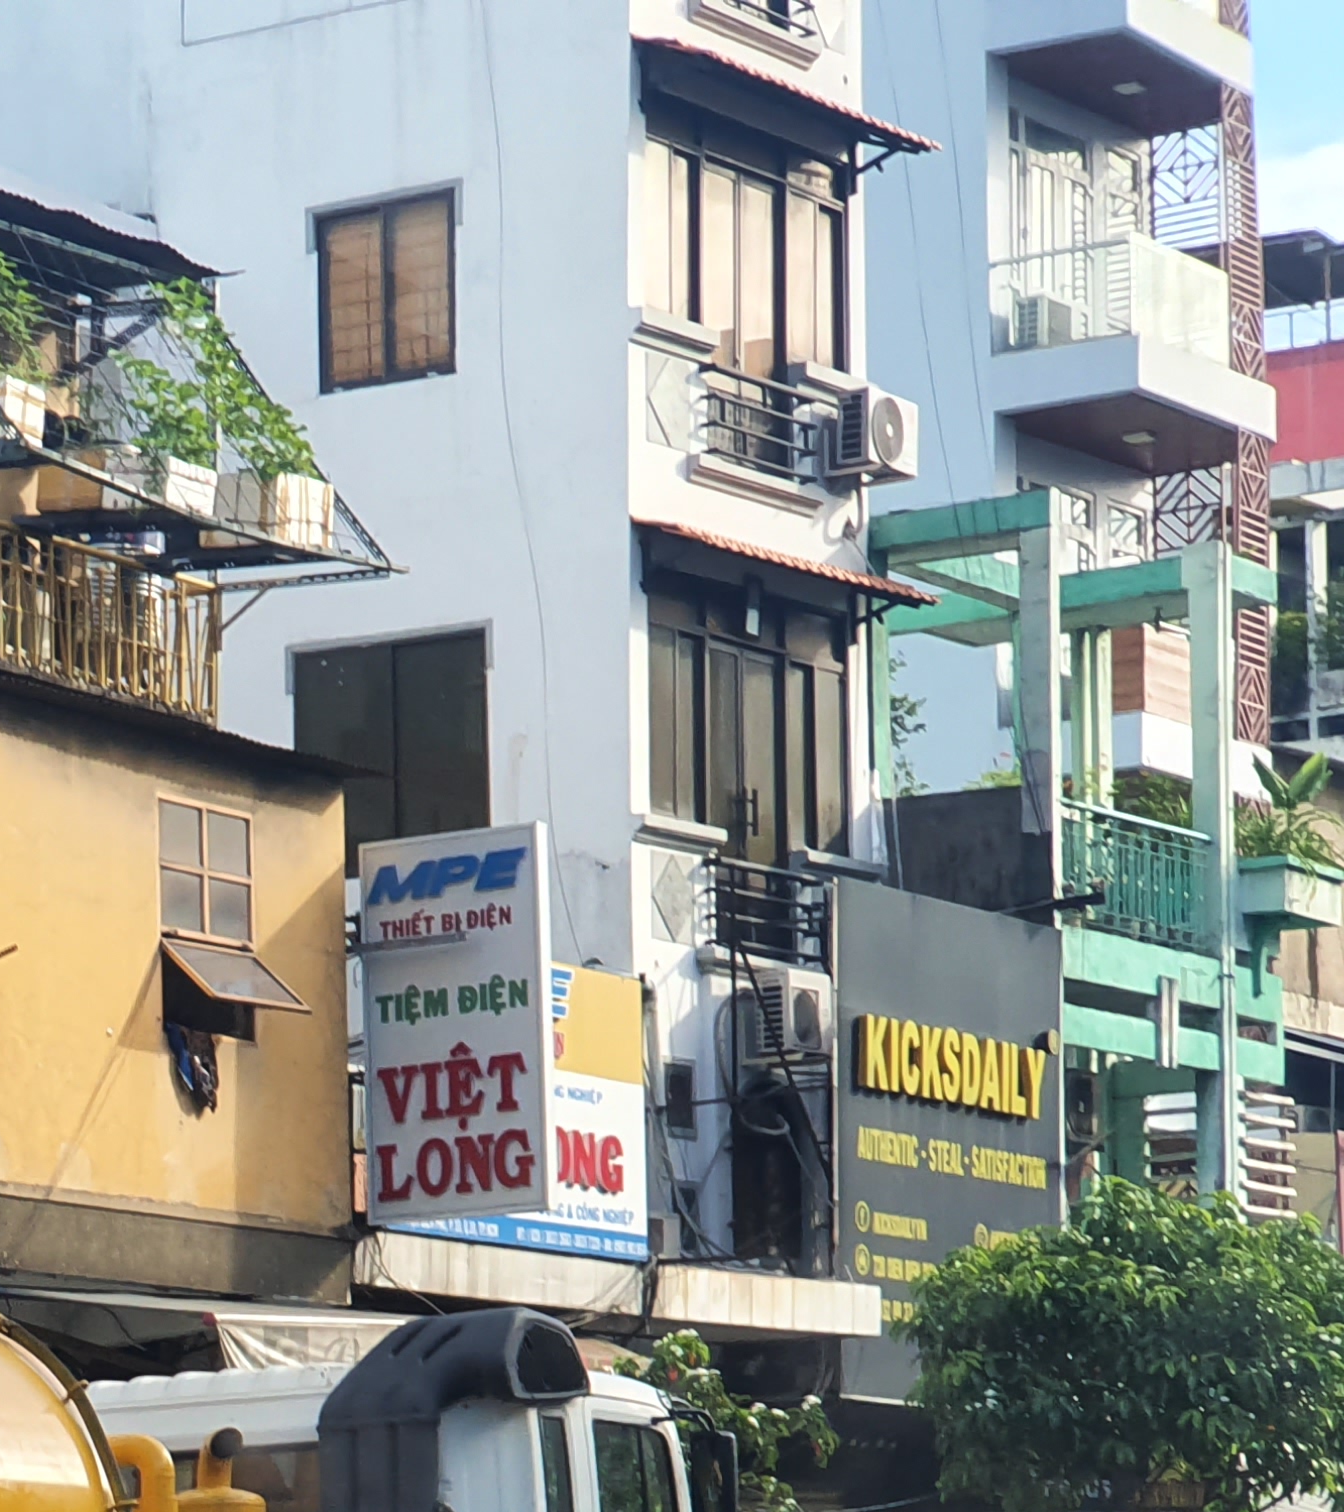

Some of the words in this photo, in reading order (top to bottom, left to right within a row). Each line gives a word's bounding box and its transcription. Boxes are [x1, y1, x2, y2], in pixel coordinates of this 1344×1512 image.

[366, 845, 528, 908] MPE
[379, 908, 435, 940] THIẾT
[465, 903, 513, 932] ĐIỆN
[374, 984, 450, 1026] TIỆM
[457, 973, 530, 1017] ĐIỆN
[376, 1041, 529, 1132] VIỆT
[864, 1013, 1047, 1120] KICKSDAILY
[375, 1128, 536, 1202] LONG
[857, 1126, 919, 1169] AUTHENTIC
[928, 1138, 965, 1177] STEAL
[971, 1145, 1047, 1190] SATISFACTION
